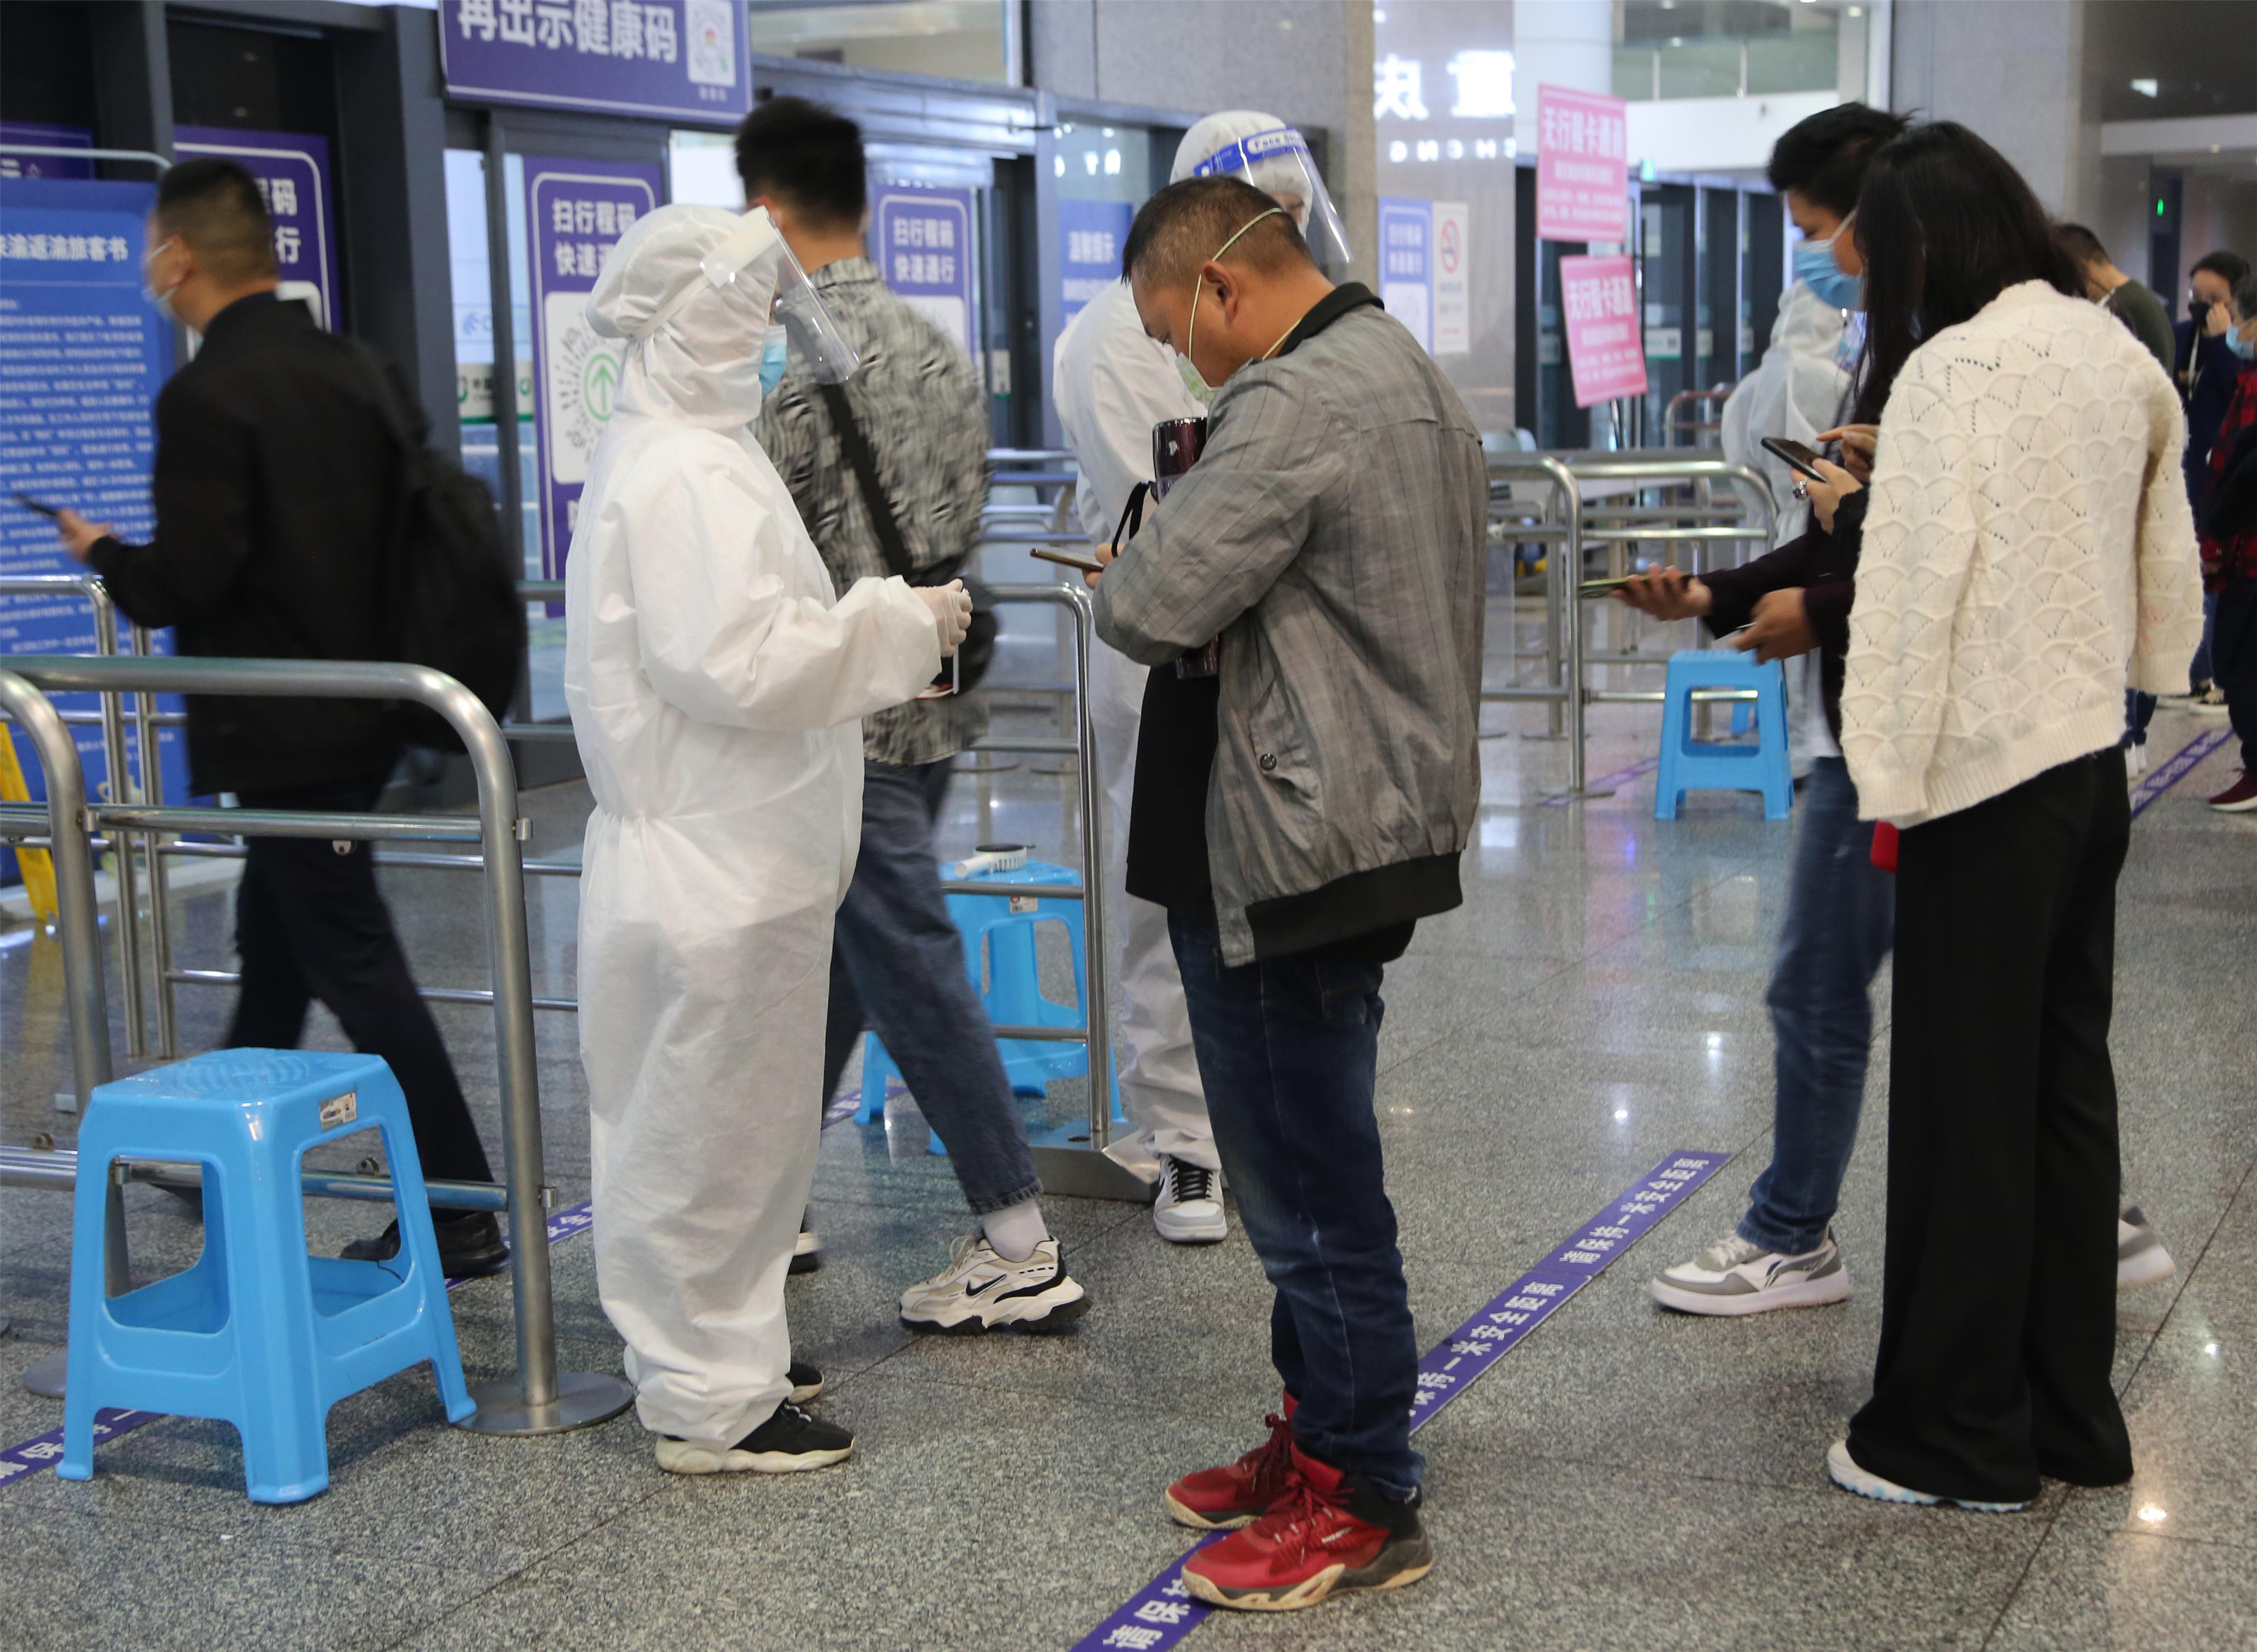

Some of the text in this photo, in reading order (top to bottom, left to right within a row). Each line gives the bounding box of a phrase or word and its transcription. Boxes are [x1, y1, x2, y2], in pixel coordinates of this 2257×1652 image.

[458, 0, 678, 63] 再出示健康码
[552, 197, 637, 235] 扫行程码
[893, 216, 955, 248] 扫行程码
[895, 253, 956, 284] 快速通行
[1559, 1157, 1709, 1264] 请保持一米安全距离
[1409, 1281, 1565, 1418] 持一米安全距离
